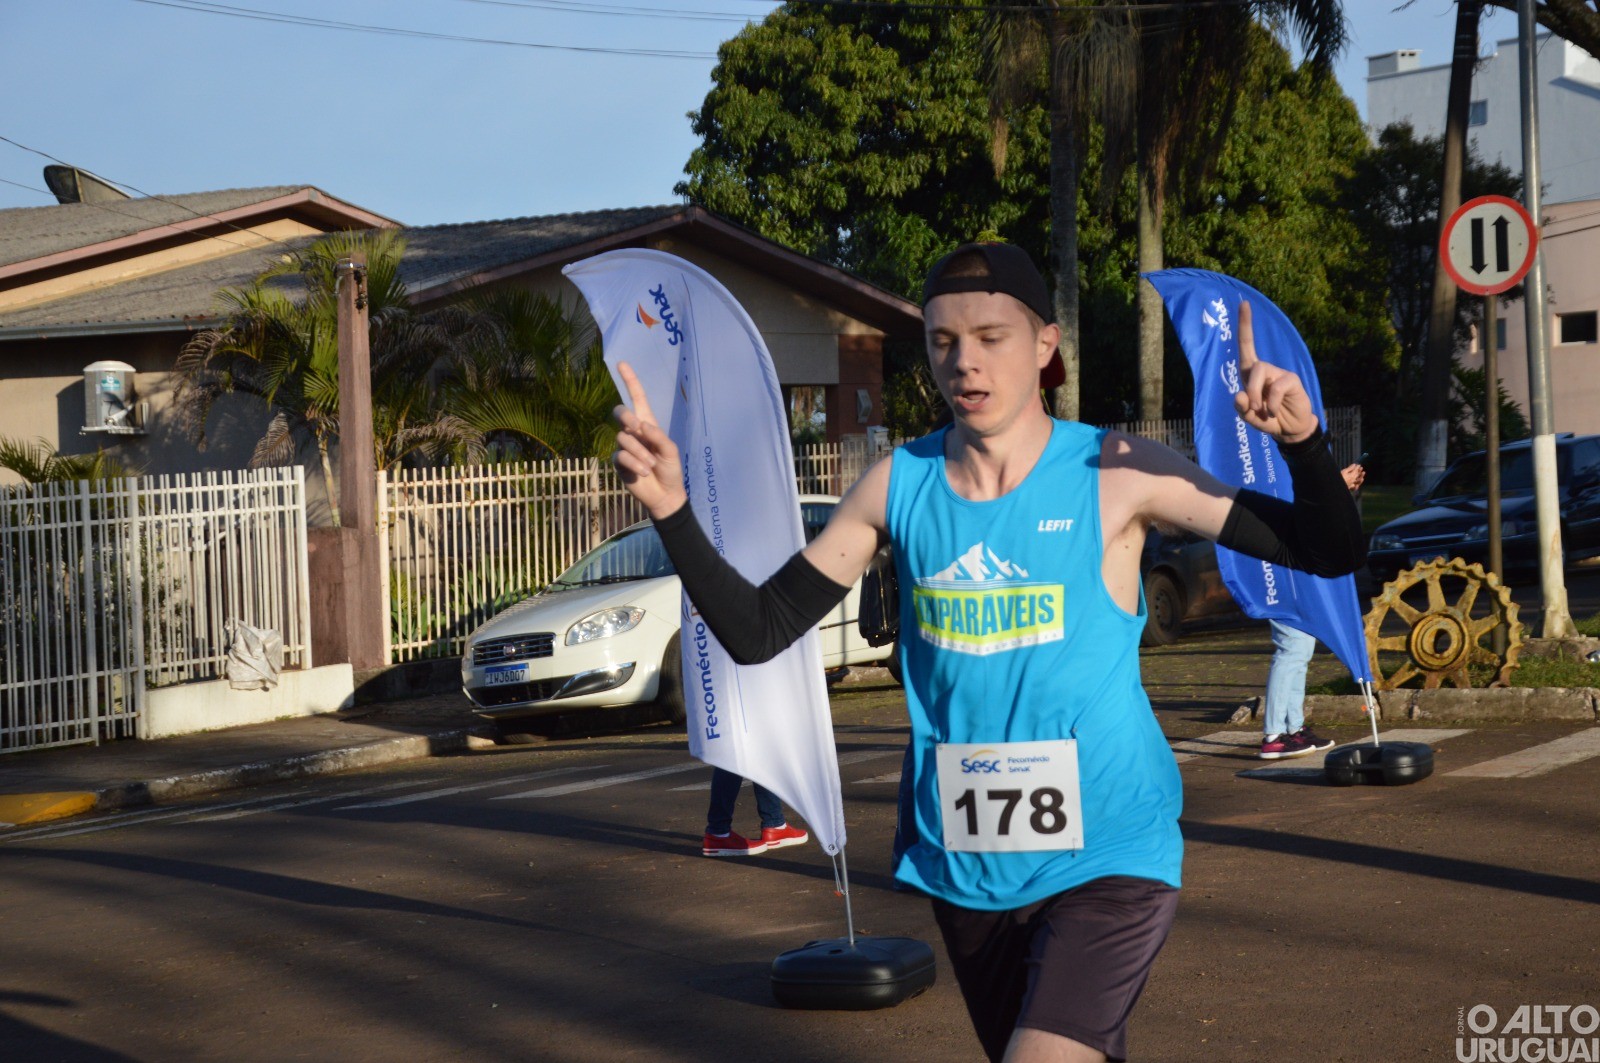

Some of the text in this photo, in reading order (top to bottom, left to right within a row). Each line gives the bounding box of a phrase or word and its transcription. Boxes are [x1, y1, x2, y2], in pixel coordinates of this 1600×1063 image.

[648, 283, 684, 346] Senac
[1211, 297, 1232, 341] Senac
[1226, 359, 1240, 394] Sesc
[703, 446, 717, 503] Comércio
[1264, 448, 1277, 484] Sistema
[1038, 519, 1074, 532] LEFIT
[1262, 560, 1279, 606] Fecom
[693, 622, 721, 740] Fecomércio
[961, 757, 1001, 773] Sesc
[955, 787, 1068, 836] 178
